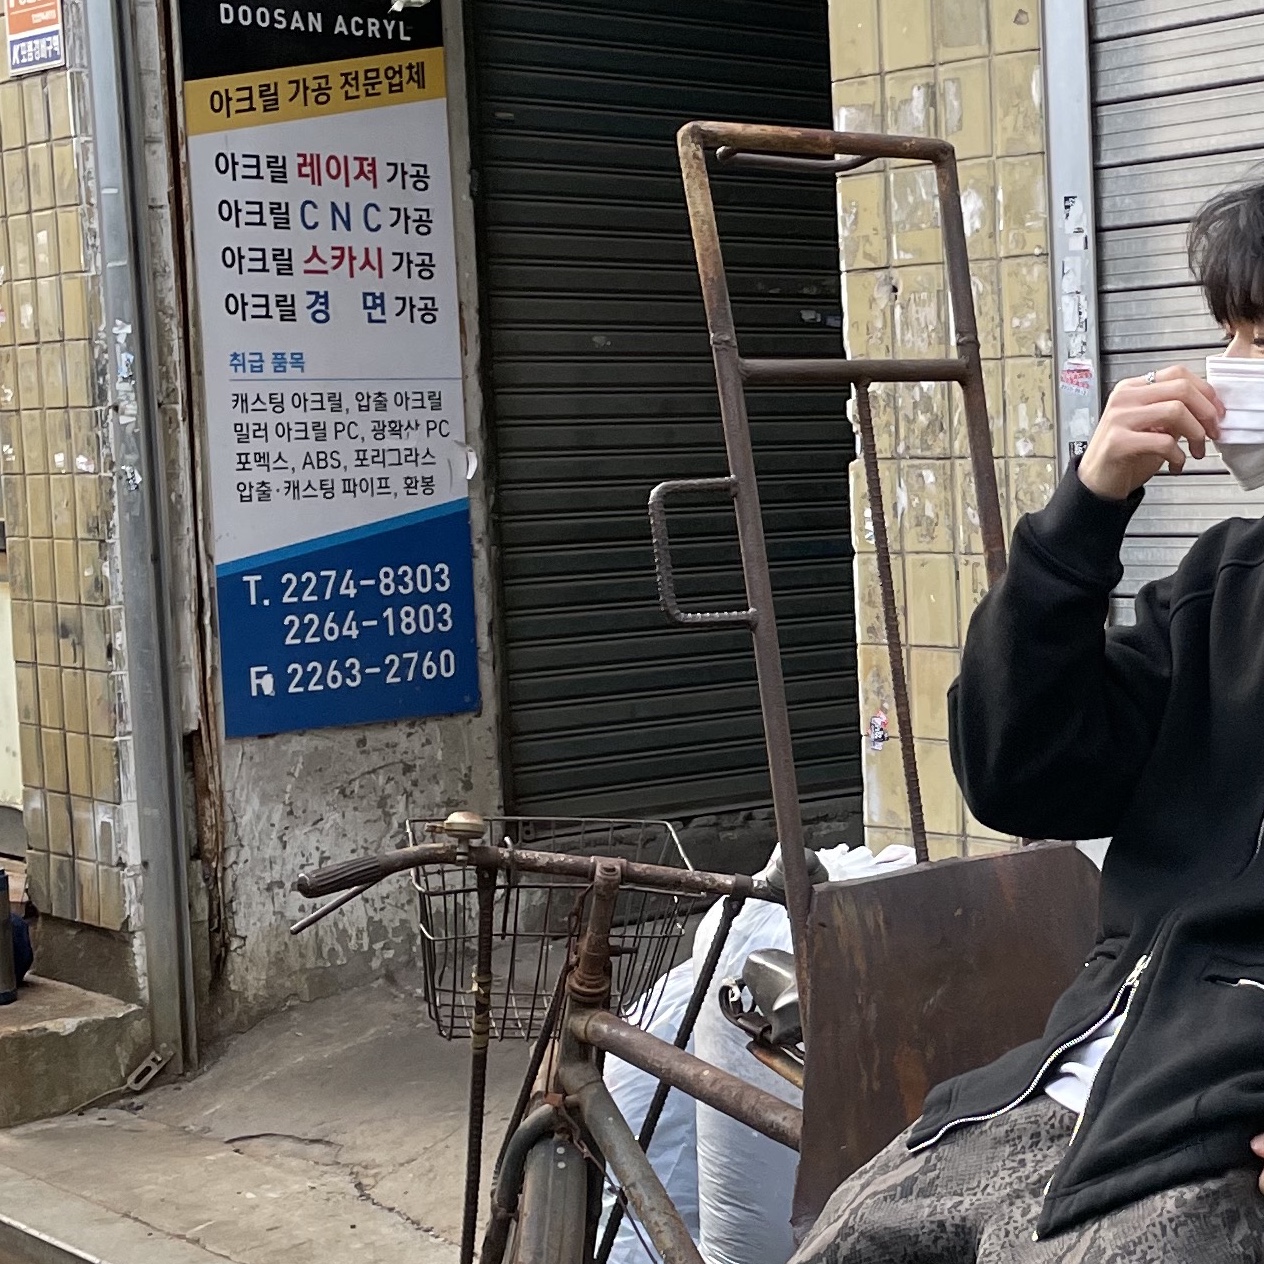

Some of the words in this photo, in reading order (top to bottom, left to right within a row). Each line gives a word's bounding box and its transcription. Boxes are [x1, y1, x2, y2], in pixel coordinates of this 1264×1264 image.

[219, 2, 323, 33] DOOSAN
[334, 14, 412, 41] ACRYL
[209, 81, 280, 118] 아크릴
[287, 74, 333, 107] 가공
[339, 61, 426, 101] 전문업체
[214, 151, 289, 184] 아크릴
[296, 152, 378, 190] 레이져
[385, 161, 431, 192] 가공
[217, 199, 291, 231] 아크릴
[388, 206, 434, 237] 가공
[221, 246, 294, 277] 아크릴
[303, 244, 384, 279] 스카시
[391, 251, 436, 281] 가공
[224, 292, 297, 323] 아크릴
[394, 295, 439, 325] 가공
[229, 351, 265, 374] 취급
[271, 351, 306, 374] 품목
[231, 392, 286, 414] 캐스팅
[291, 391, 350, 415] 아크릴,
[354, 390, 388, 413] 압출
[393, 390, 443, 413] 아크릴
[233, 421, 269, 444] 밀러
[274, 421, 328, 443] 아크릴
[334, 420, 366, 444] PC,
[370, 419, 420, 441] 광확산
[426, 419, 450, 438] PC
[235, 450, 296, 474] 포멕스,
[301, 450, 348, 473] ABS,
[354, 446, 437, 469] 포리그라스
[341, 476, 399, 500] 파이프,
[402, 474, 436, 497] 환봉
[242, 574, 270, 606] T.
[280, 562, 451, 604] 2274-8303
[283, 602, 453, 645] 2264-1803
[286, 649, 455, 694] 2263-2760
